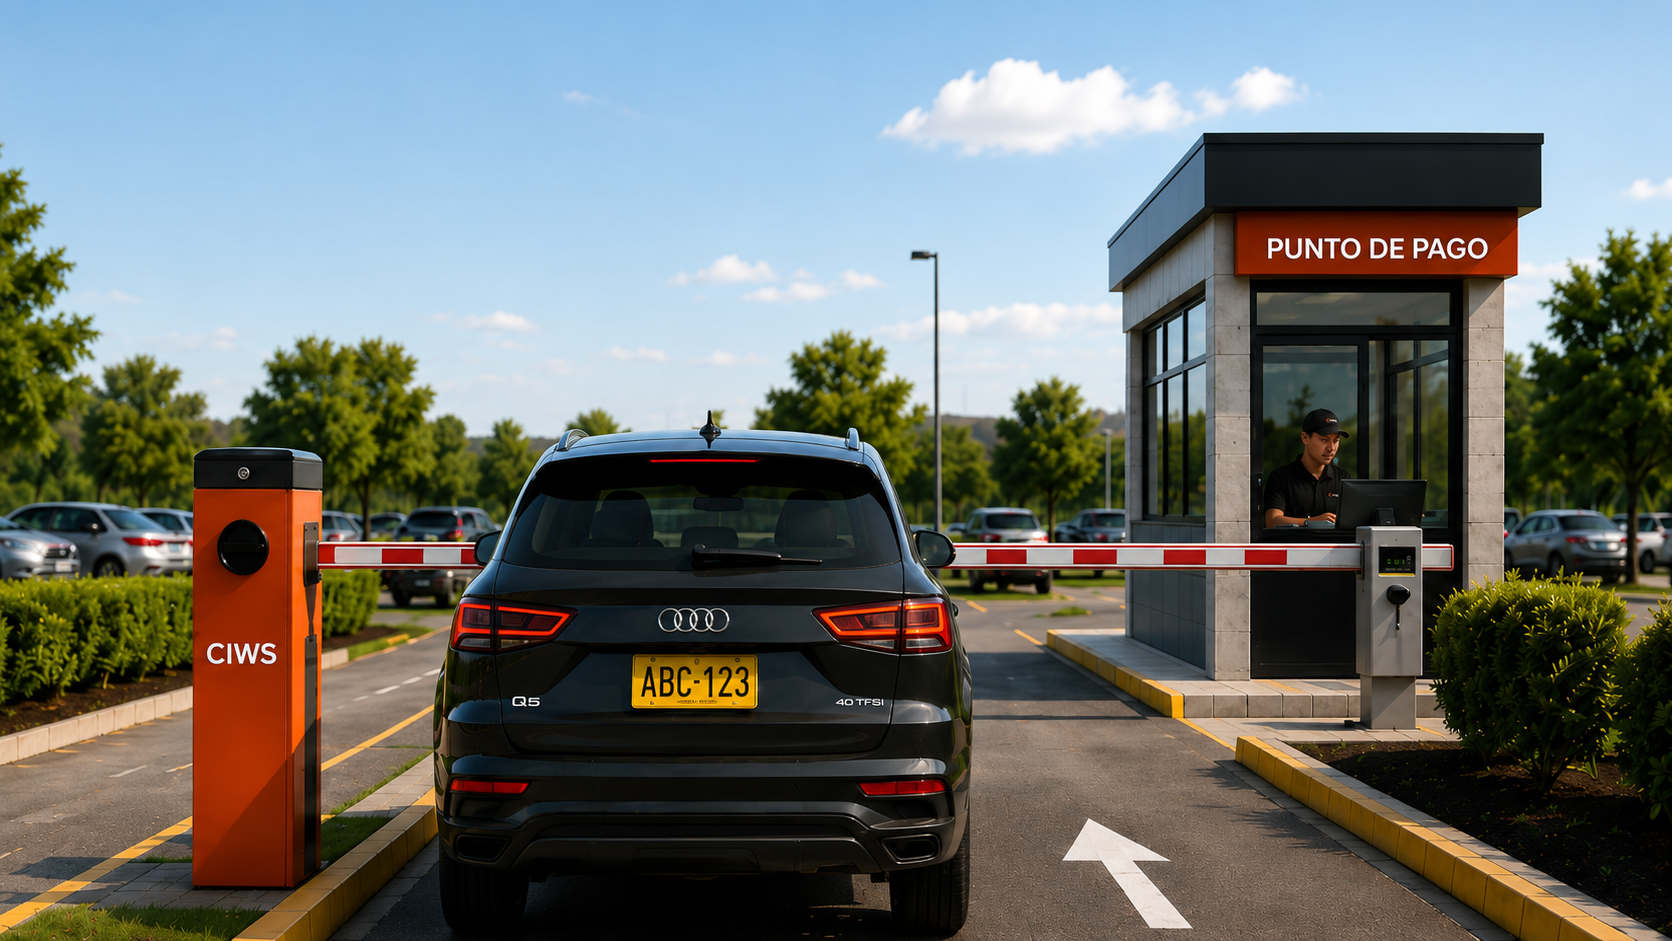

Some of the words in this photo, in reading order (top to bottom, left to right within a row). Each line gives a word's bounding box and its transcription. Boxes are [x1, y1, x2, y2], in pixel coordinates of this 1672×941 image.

[1267, 238, 1361, 259] PUNTO
[1369, 238, 1404, 259] DE
[1413, 238, 1488, 259] PAGO
[206, 642, 277, 665] CIWS
[641, 666, 749, 697] ABC-123
[511, 696, 541, 708] Q5
[835, 698, 854, 707] 40
[855, 698, 884, 707] TFSI
